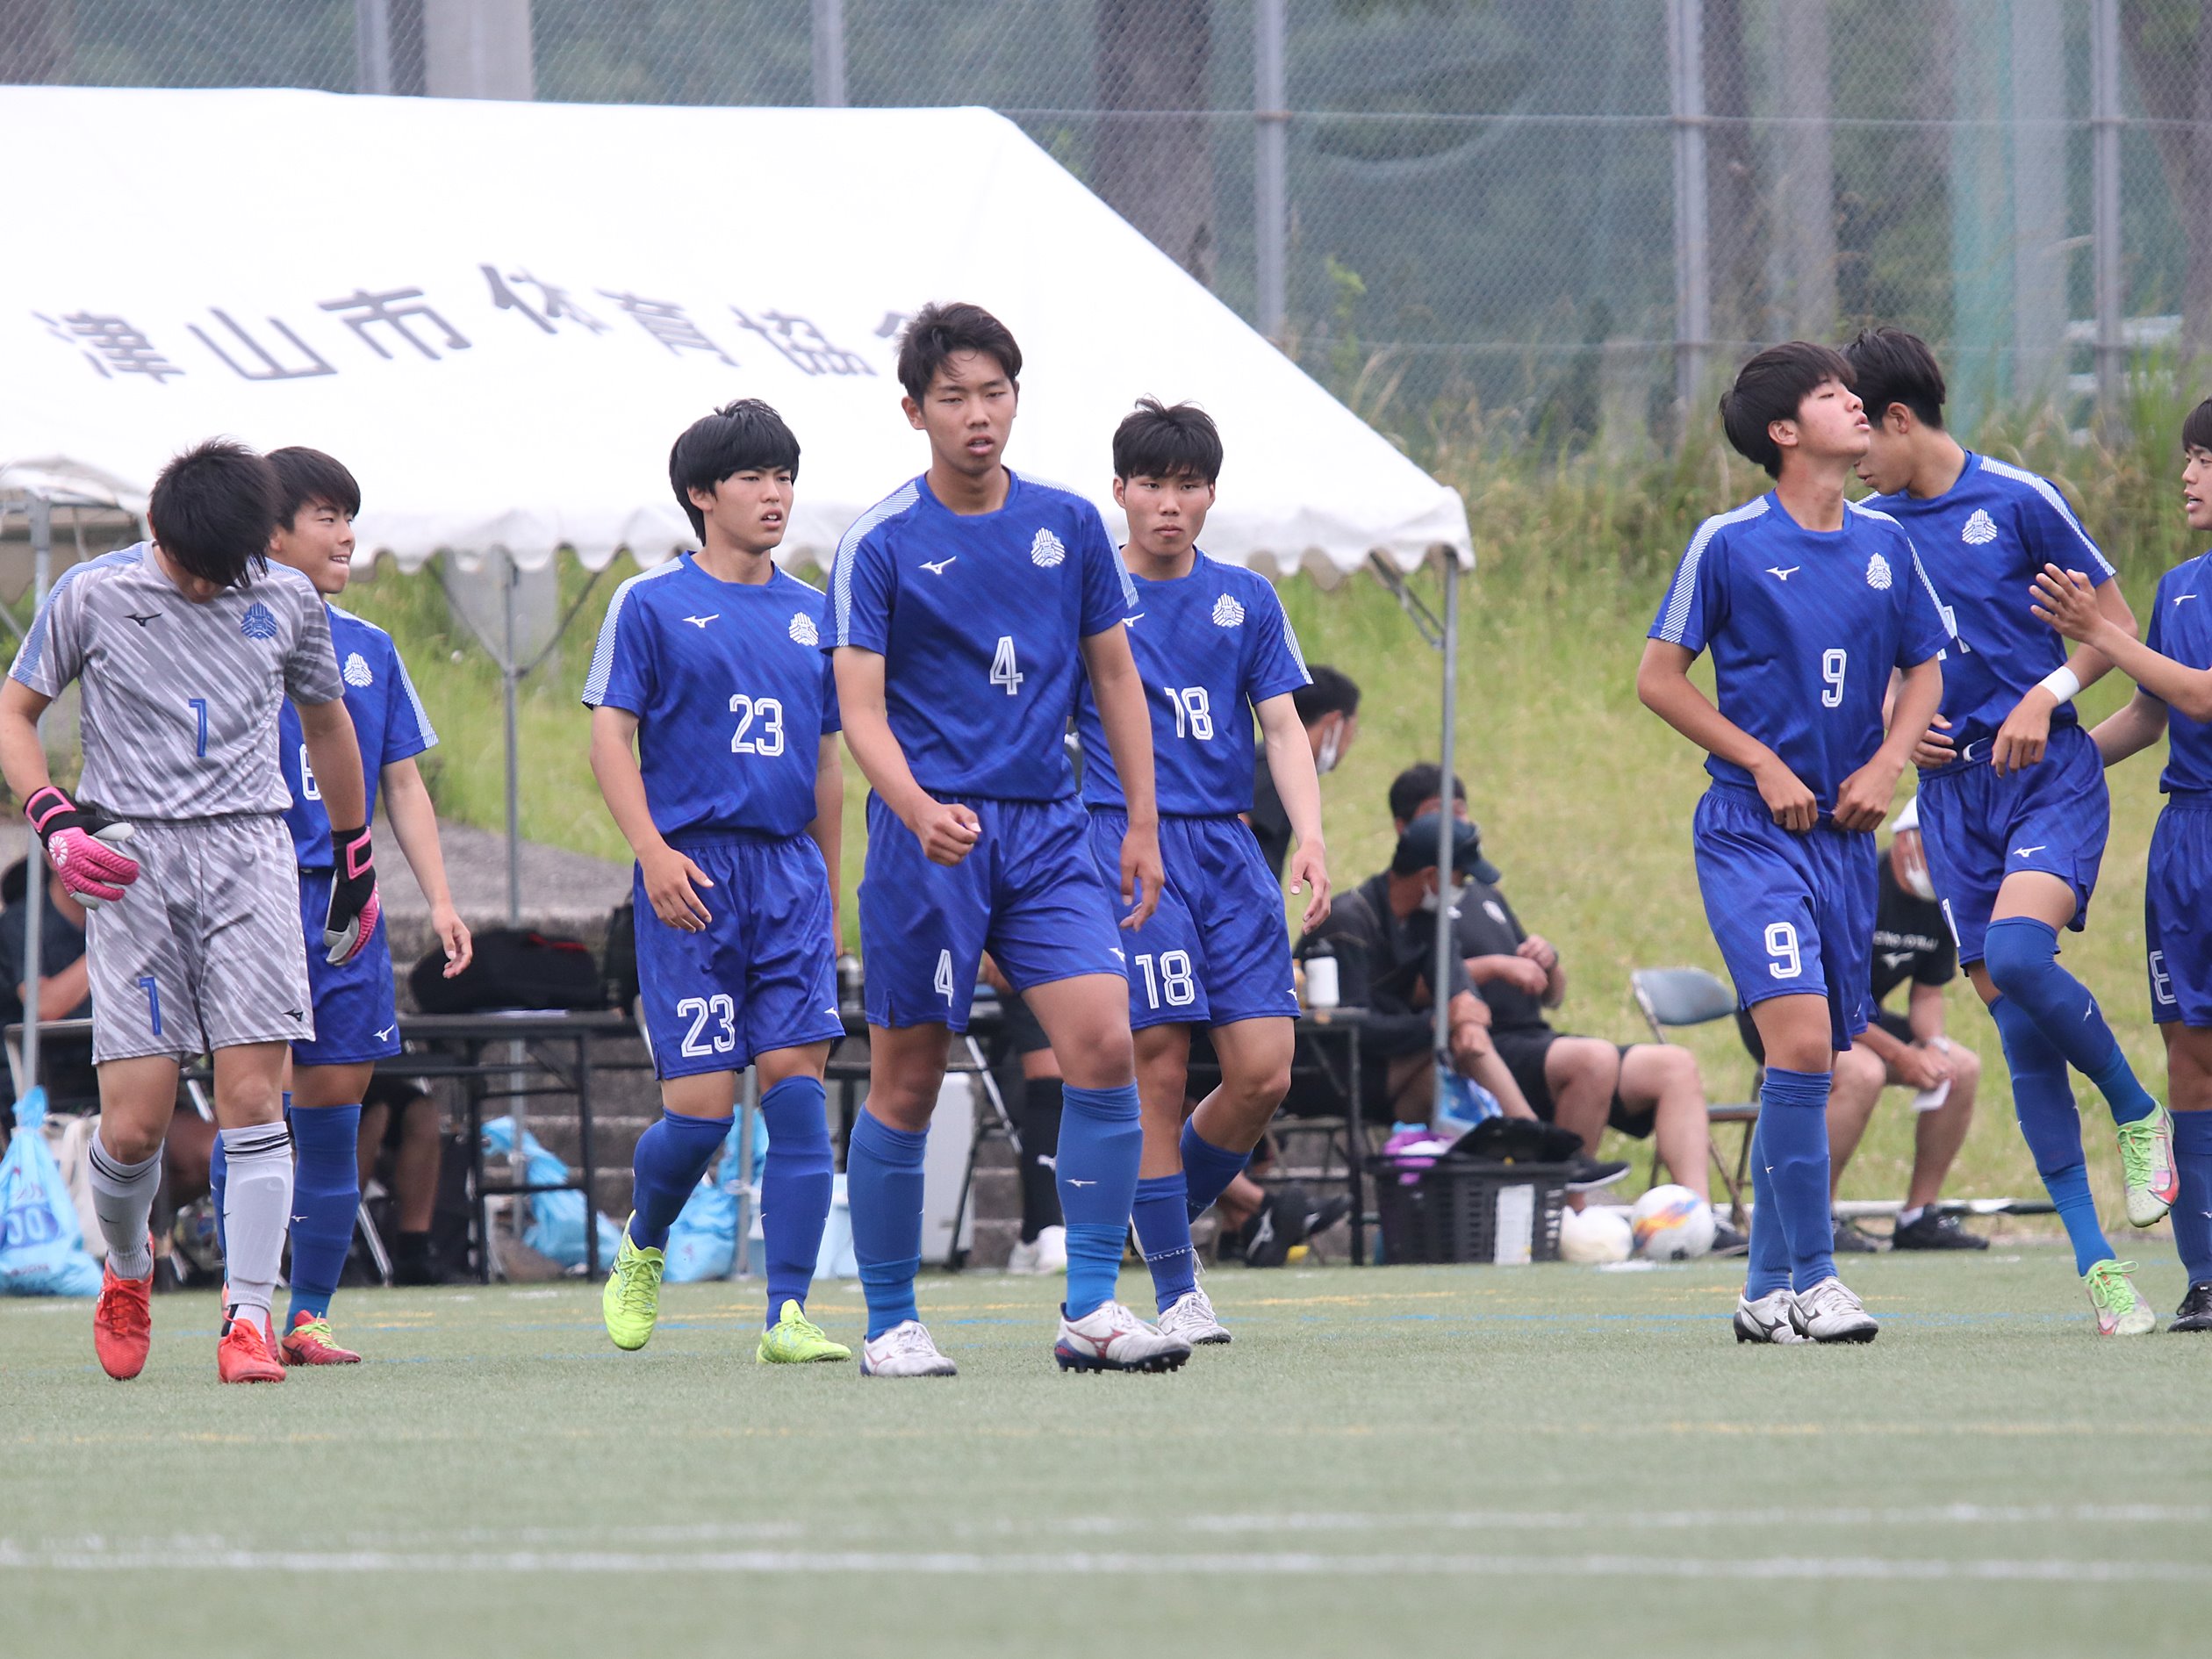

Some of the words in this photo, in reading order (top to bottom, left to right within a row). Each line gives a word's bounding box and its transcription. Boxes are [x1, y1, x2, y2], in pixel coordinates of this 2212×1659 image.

[989, 636, 1023, 695] 4
[1821, 648, 1847, 707] 9
[188, 698, 209, 758] 1
[729, 693, 785, 757] 23
[1163, 686, 1214, 741] 18
[933, 949, 954, 1008] 4
[1135, 949, 1196, 1009] 18
[1764, 922, 1802, 980] 9
[140, 976, 162, 1037] 1
[677, 993, 736, 1058] 23
